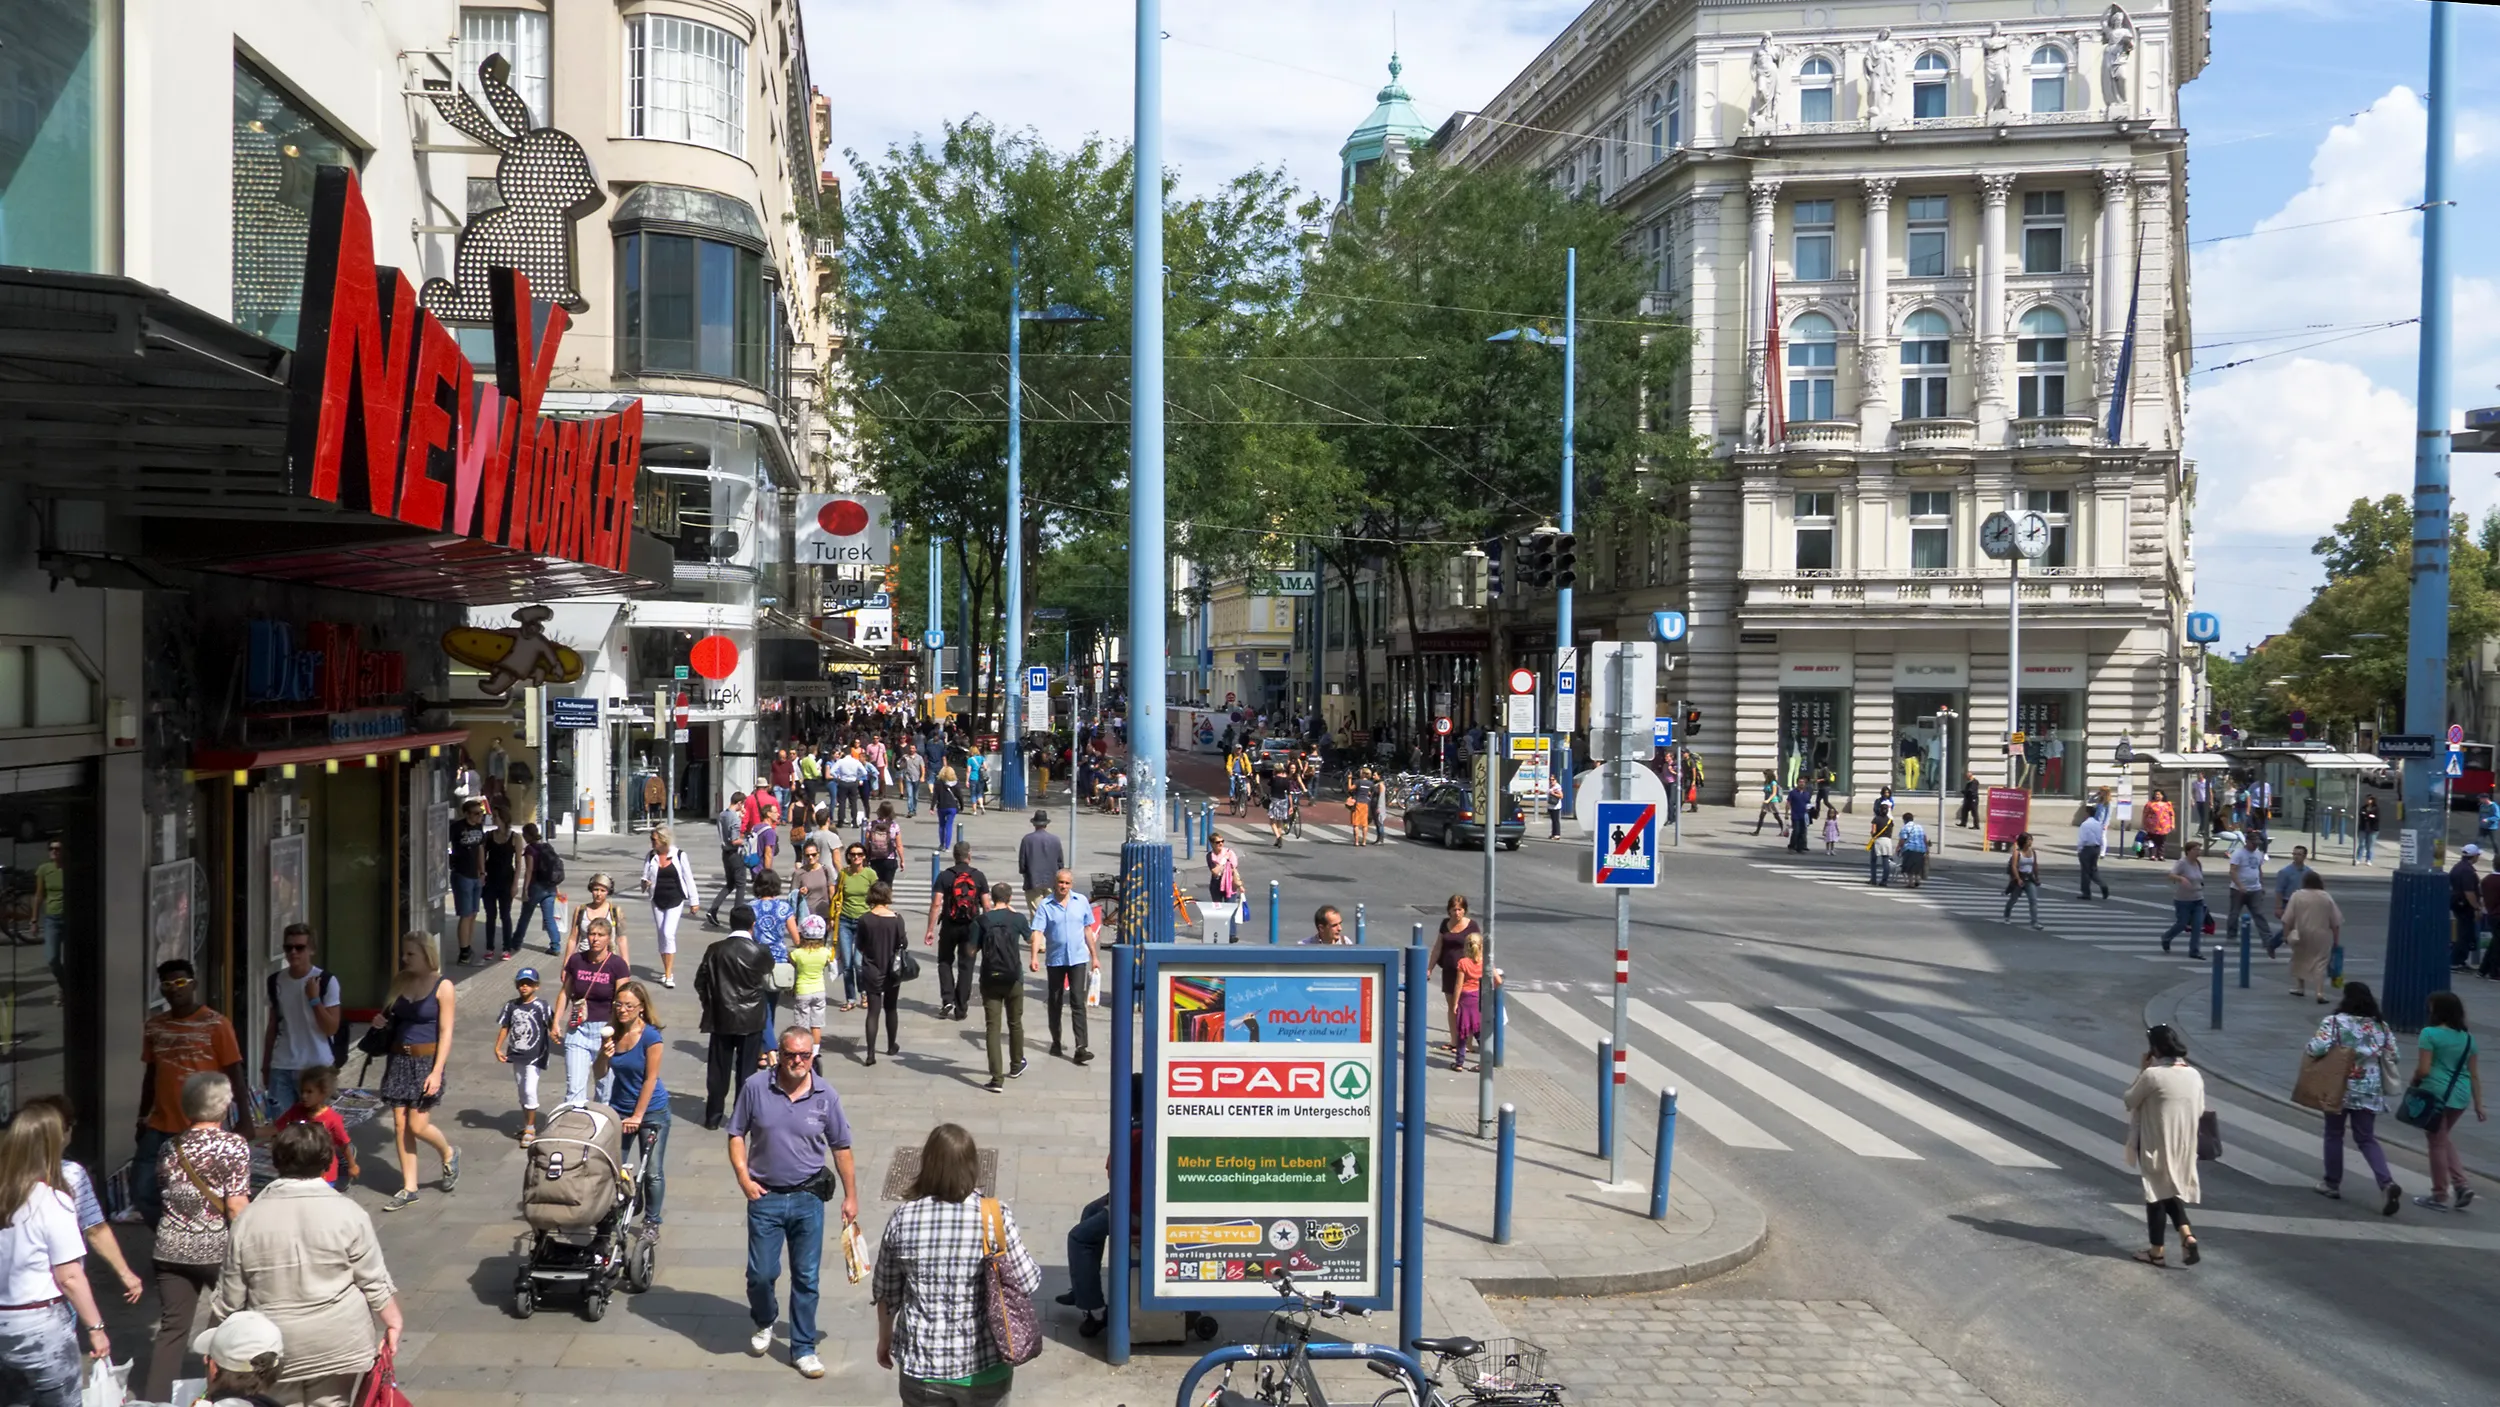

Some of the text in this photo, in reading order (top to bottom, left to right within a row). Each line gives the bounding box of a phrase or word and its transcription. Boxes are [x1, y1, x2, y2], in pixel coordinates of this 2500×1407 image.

[308, 166, 643, 574] NEW YORKER
[812, 542, 873, 560] Turek
[829, 584, 858, 596] VIP
[1663, 618, 1681, 637] U
[2192, 617, 2215, 640] U
[928, 634, 940, 647] U
[683, 683, 742, 705] Turek
[1438, 721, 1448, 730] 20
[1656, 724, 1668, 732] Taxi
[1268, 1004, 1357, 1024] mastnak
[1277, 1026, 1348, 1037] Papier sind wir!
[1172, 1067, 1321, 1092] SPAR
[1167, 1104, 1371, 1119] GENERALI CENTER im Untergeschoß
[1177, 1156, 1326, 1170] Mehr Erfolg im Leben!
[1178, 1173, 1326, 1184] www.coachingakademie.at
[1306, 1224, 1360, 1240] Martens
[1322, 1259, 1361, 1267] clothing
[1334, 1266, 1361, 1274] shoes
